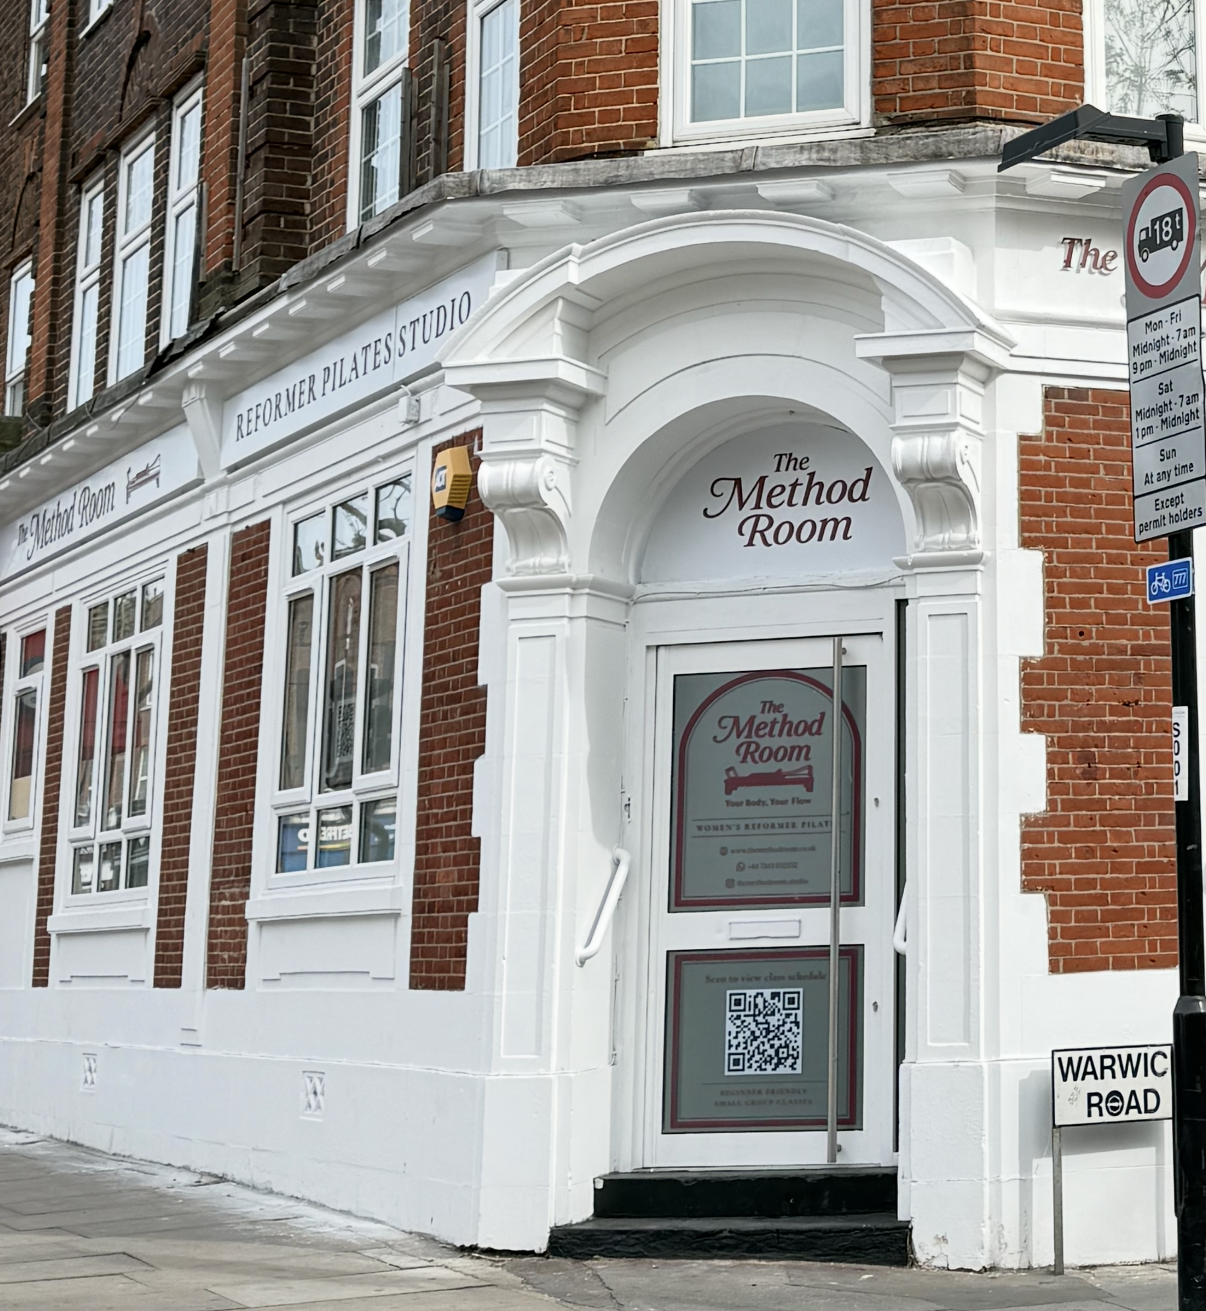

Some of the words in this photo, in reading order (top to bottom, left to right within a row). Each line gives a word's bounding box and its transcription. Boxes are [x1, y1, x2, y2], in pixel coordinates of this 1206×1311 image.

[1061, 237, 1118, 271] The
[1145, 320, 1163, 334] Mon
[1170, 309, 1182, 325] Fri
[1133, 333, 1170, 358] Midnight
[1159, 340, 1197, 365] Midnight
[235, 373, 317, 442] REFORMER
[321, 332, 392, 397] PILATES
[397, 291, 472, 358] STUDIO
[1158, 379, 1173, 395] Sat
[1135, 399, 1173, 423] Midnight
[1160, 407, 1200, 431] Midnight
[773, 452, 810, 472] The
[1159, 449, 1177, 462] Sun
[1144, 472, 1154, 486] At
[1156, 469, 1172, 482] any
[1174, 462, 1194, 477] time
[702, 466, 874, 519] Method
[1154, 492, 1184, 511] Except
[17, 523, 28, 546] The
[26, 491, 78, 561] Method
[77, 481, 116, 529] Room
[737, 513, 853, 547] Room
[1138, 514, 1167, 535] permit
[1169, 506, 1203, 525] holders
[760, 700, 785, 714] The
[712, 711, 826, 743] Method
[735, 740, 812, 764] Room
[725, 799, 744, 808] Your
[770, 797, 789, 807] Your
[791, 796, 812, 805] Flow
[696, 823, 741, 832] WOMEN'S
[744, 821, 798, 831] REFORMER
[801, 820, 832, 829] PILAT
[705, 974, 727, 984] Scan
[728, 975, 739, 983] to
[741, 974, 762, 983] view
[1057, 1050, 1168, 1082] WARWIC
[1086, 1088, 1161, 1118] ROAD
